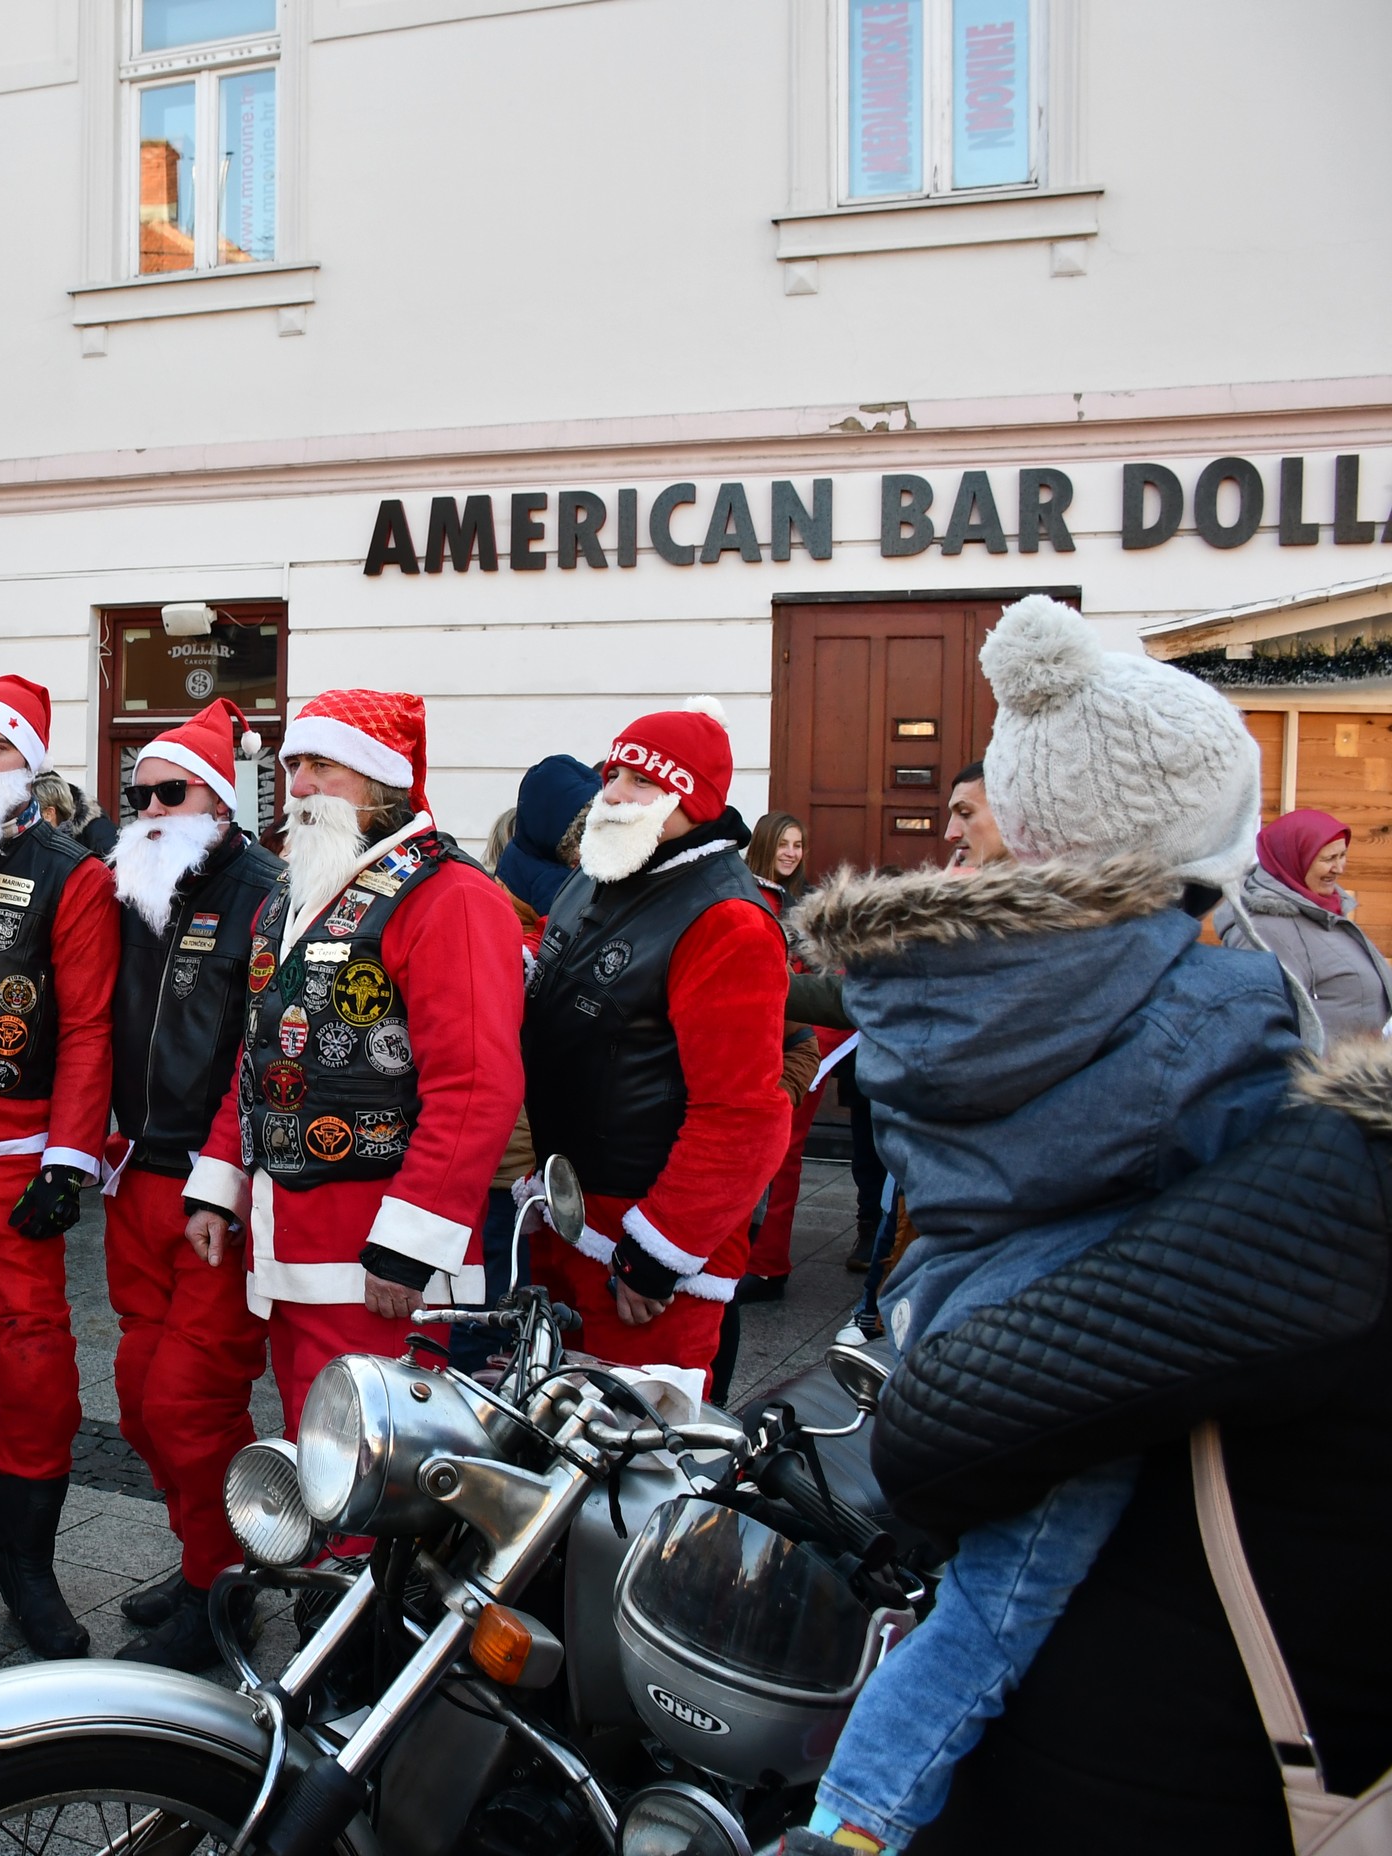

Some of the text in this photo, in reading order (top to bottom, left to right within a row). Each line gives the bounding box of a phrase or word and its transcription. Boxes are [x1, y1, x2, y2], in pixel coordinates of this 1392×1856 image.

[965, 22, 1015, 132] NOVINE
[363, 478, 834, 576] AMERICAN
[881, 466, 1077, 557] BAR
[172, 644, 230, 658] DOLLAR
[2, 877, 26, 889] MARINO
[315, 1021, 359, 1044] MOTO LEGIJA
[372, 1025, 381, 1033] MK
[317, 1055, 349, 1068] CROATIA
